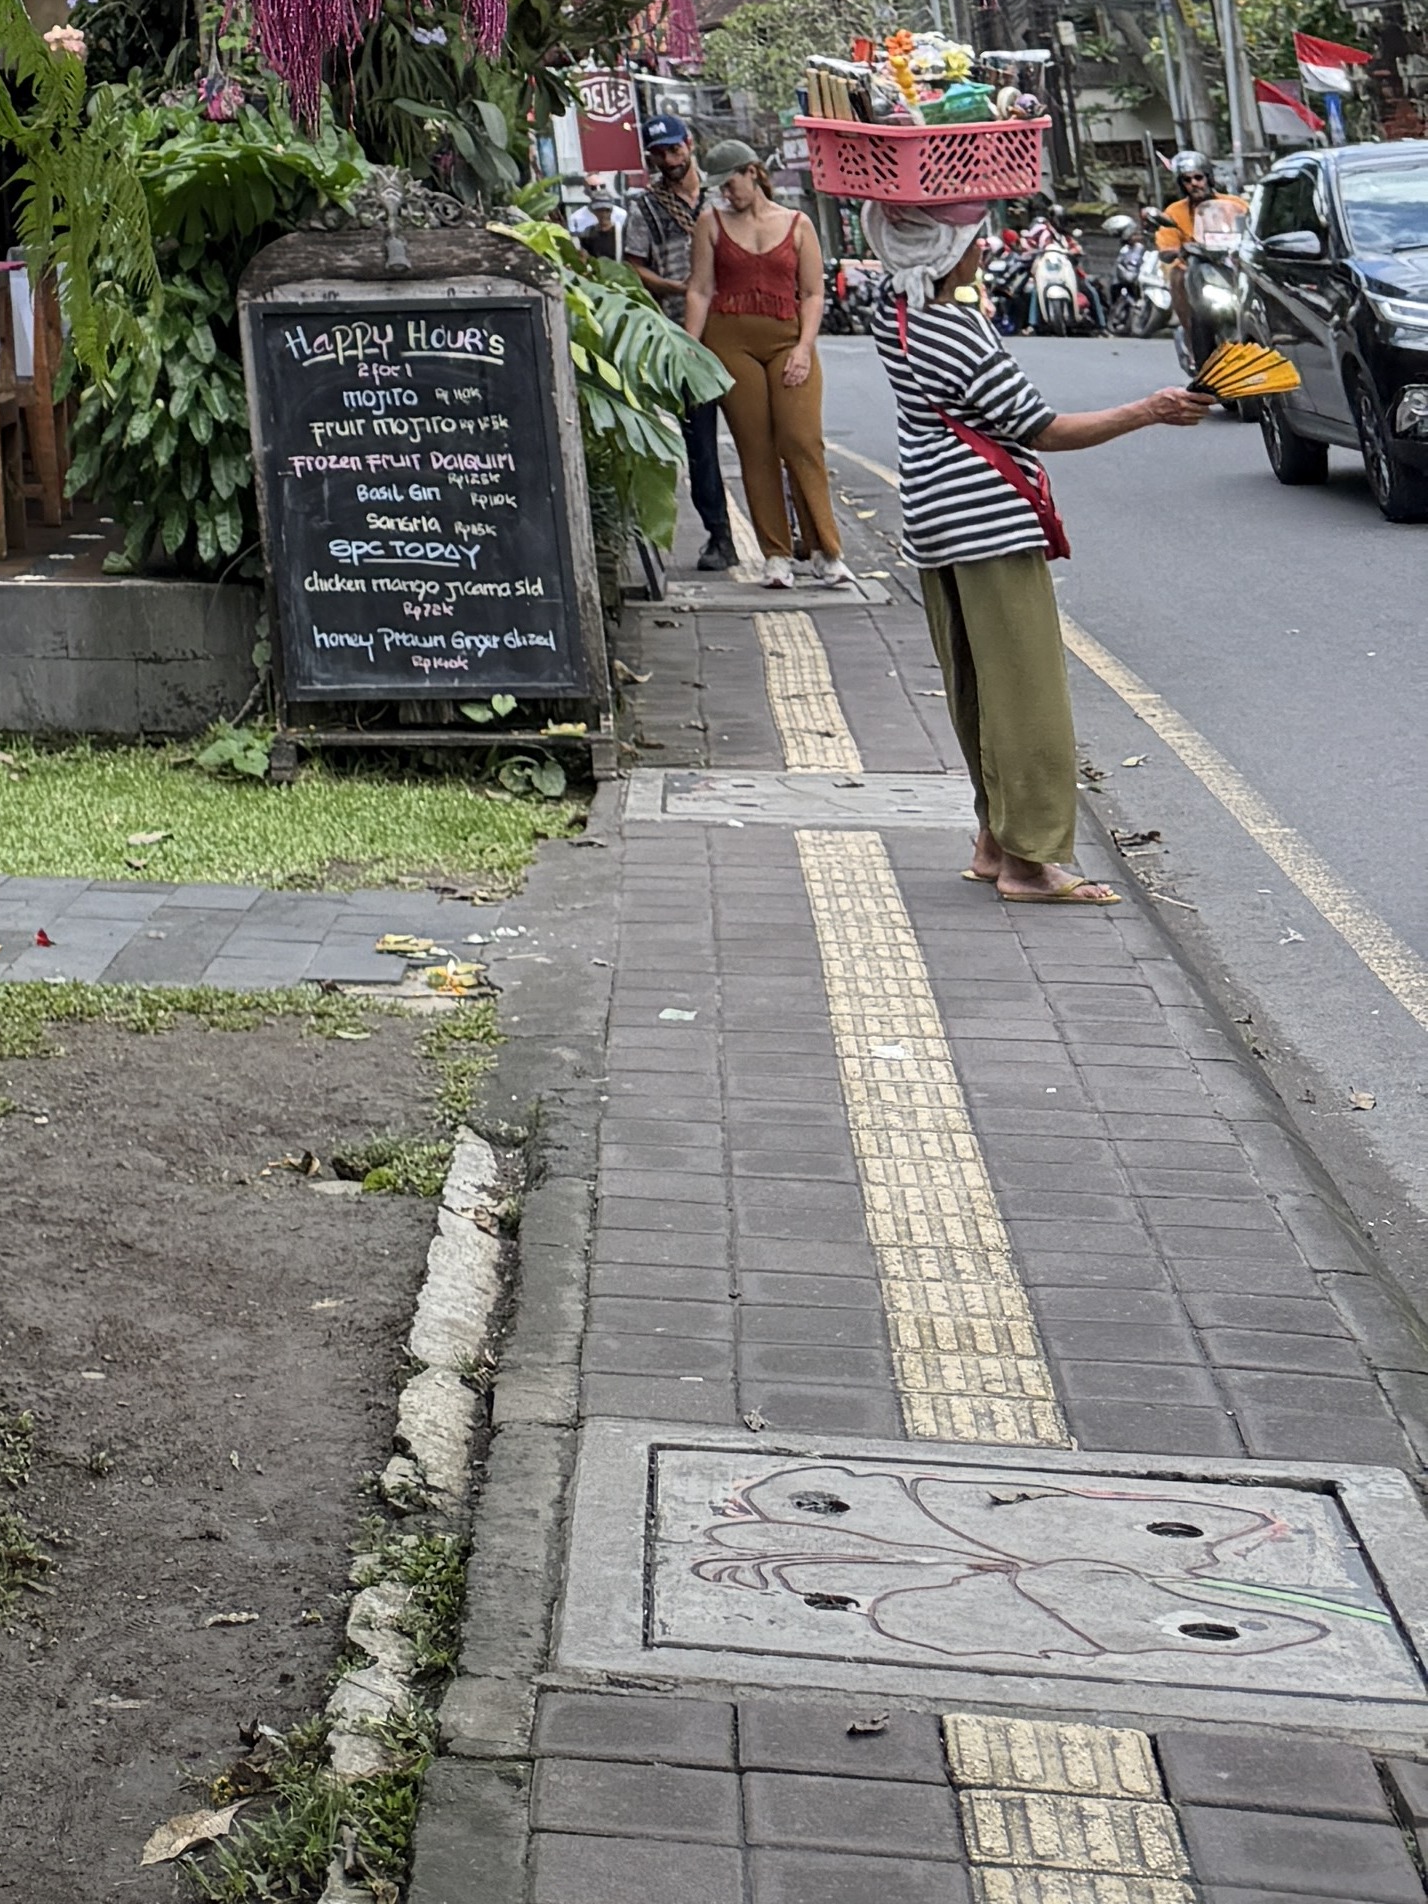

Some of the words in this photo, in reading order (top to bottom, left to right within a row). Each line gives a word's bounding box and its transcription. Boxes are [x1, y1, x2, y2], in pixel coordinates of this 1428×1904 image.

[357, 362, 369, 377] 2
[372, 363, 401, 386] for
[405, 362, 413, 378] 1
[388, 540, 481, 571] TODAY
[371, 578, 440, 602] mango
[313, 625, 374, 663] honey
